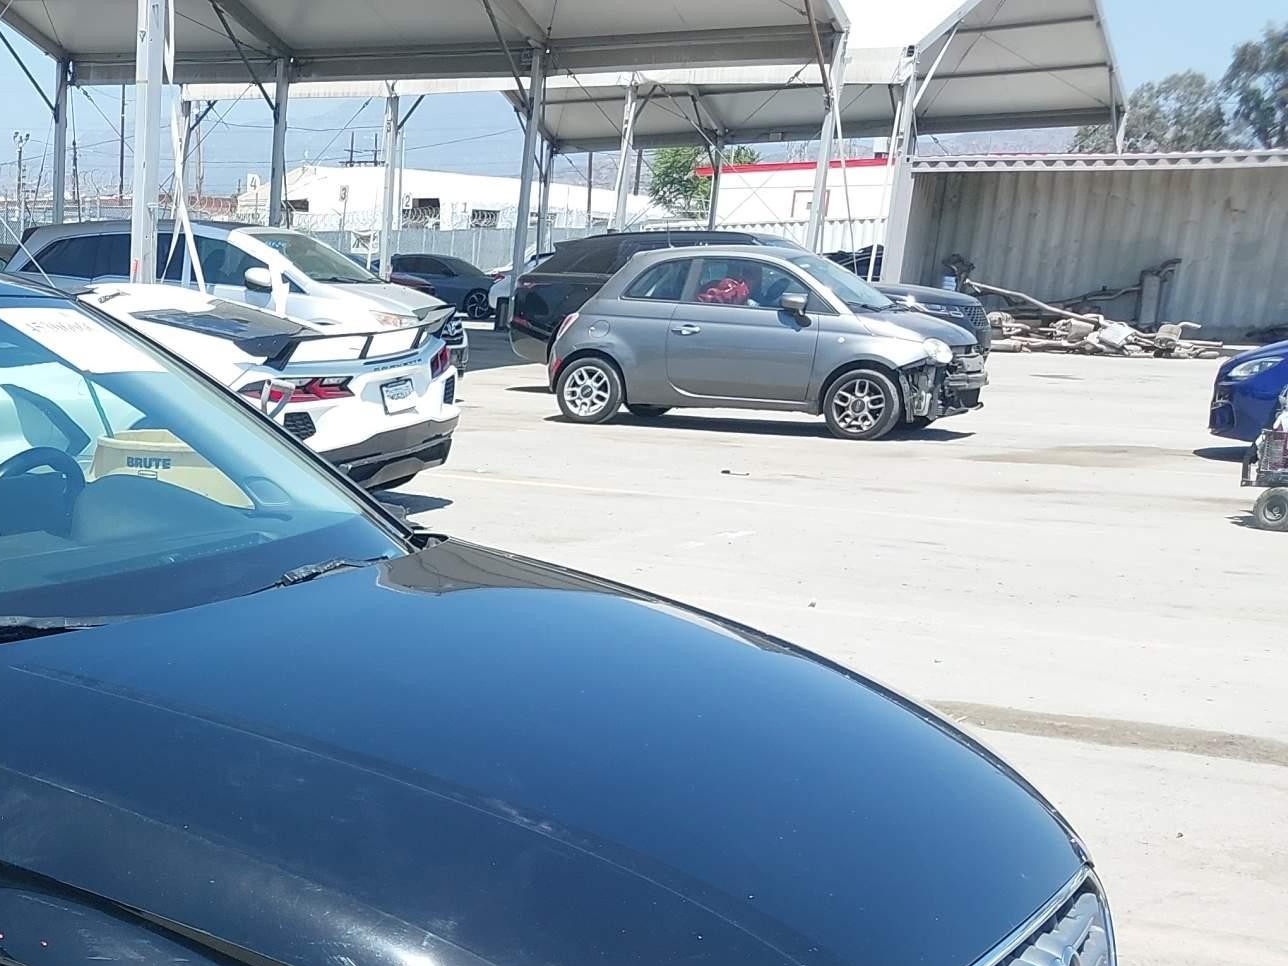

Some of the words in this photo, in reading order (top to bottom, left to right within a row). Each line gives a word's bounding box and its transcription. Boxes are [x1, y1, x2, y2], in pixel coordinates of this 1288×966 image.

[249, 175, 257, 191] 4
[340, 186, 347, 201] 3
[404, 194, 411, 208] 2
[126, 455, 172, 470] BRUTE
